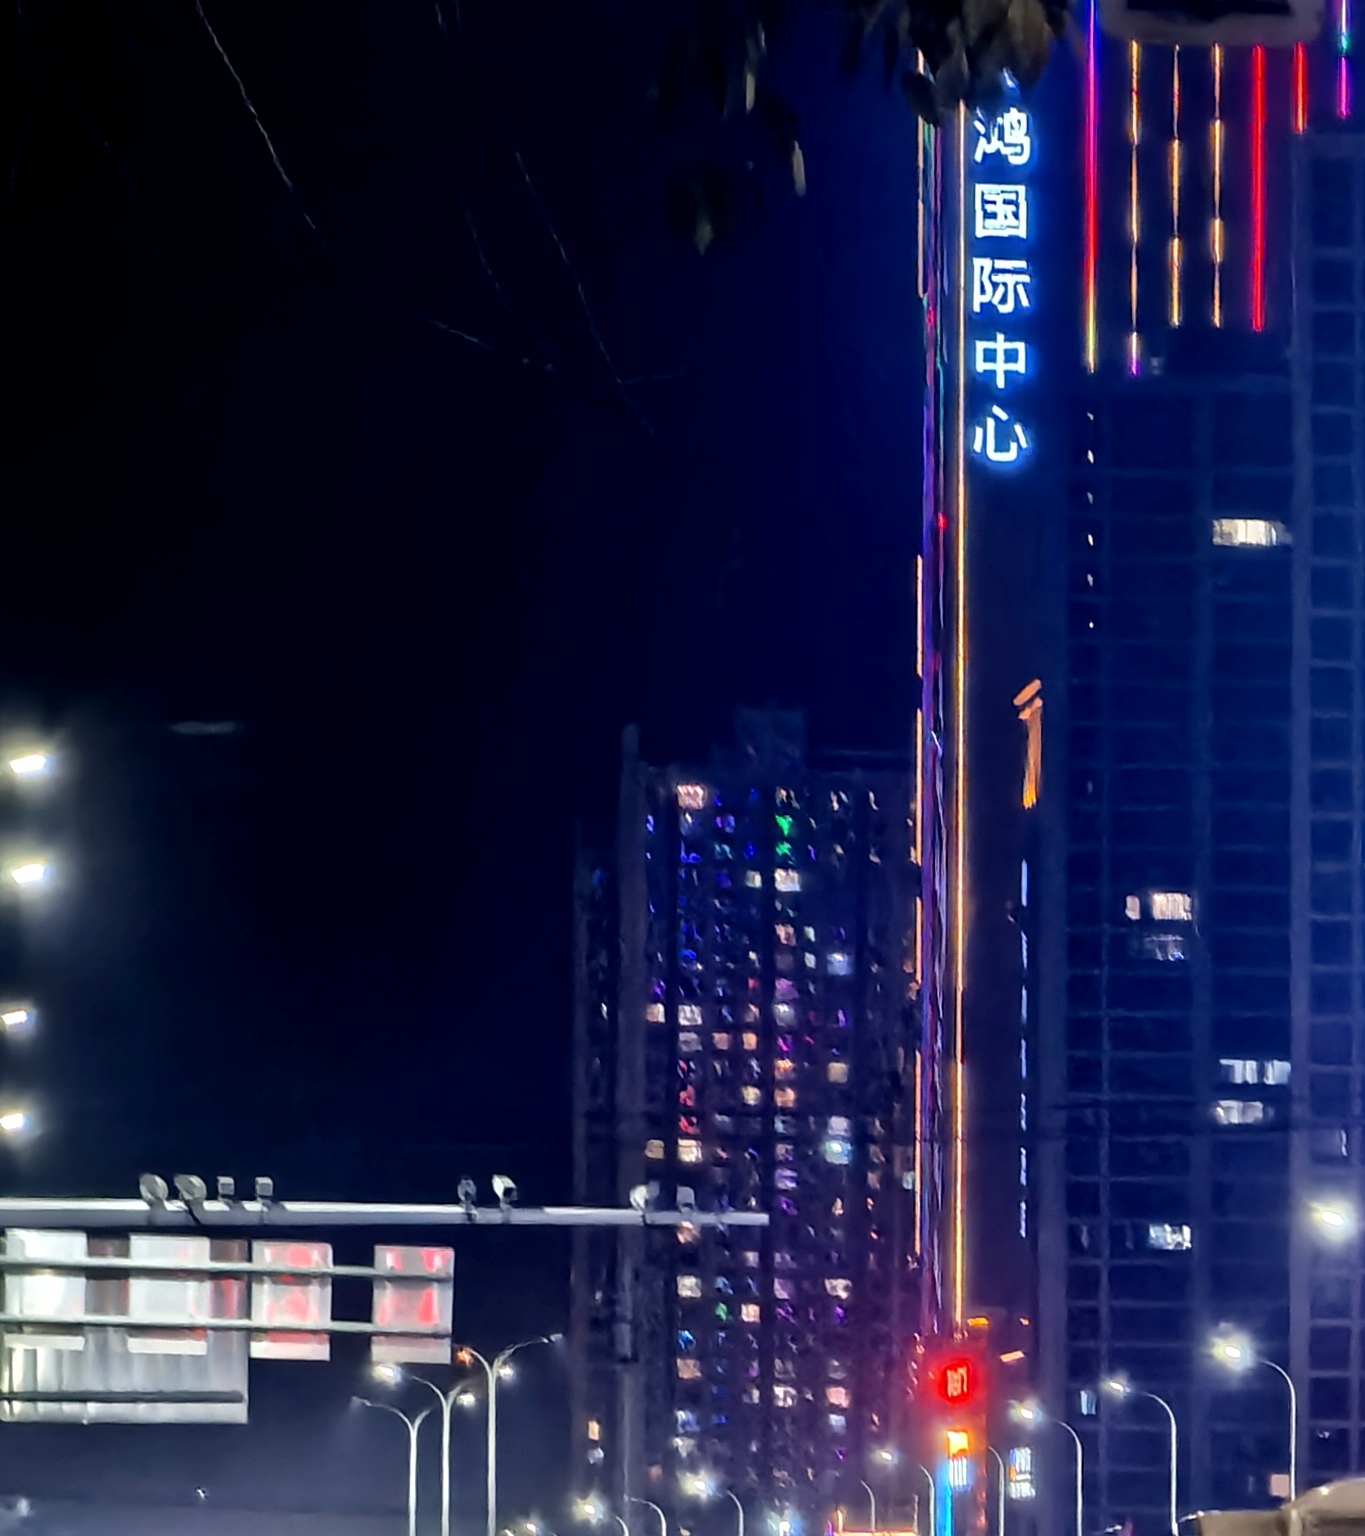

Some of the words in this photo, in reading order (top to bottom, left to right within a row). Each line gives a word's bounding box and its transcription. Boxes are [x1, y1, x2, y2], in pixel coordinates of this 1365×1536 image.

[973, 67, 1032, 463] 鸿国际中心
